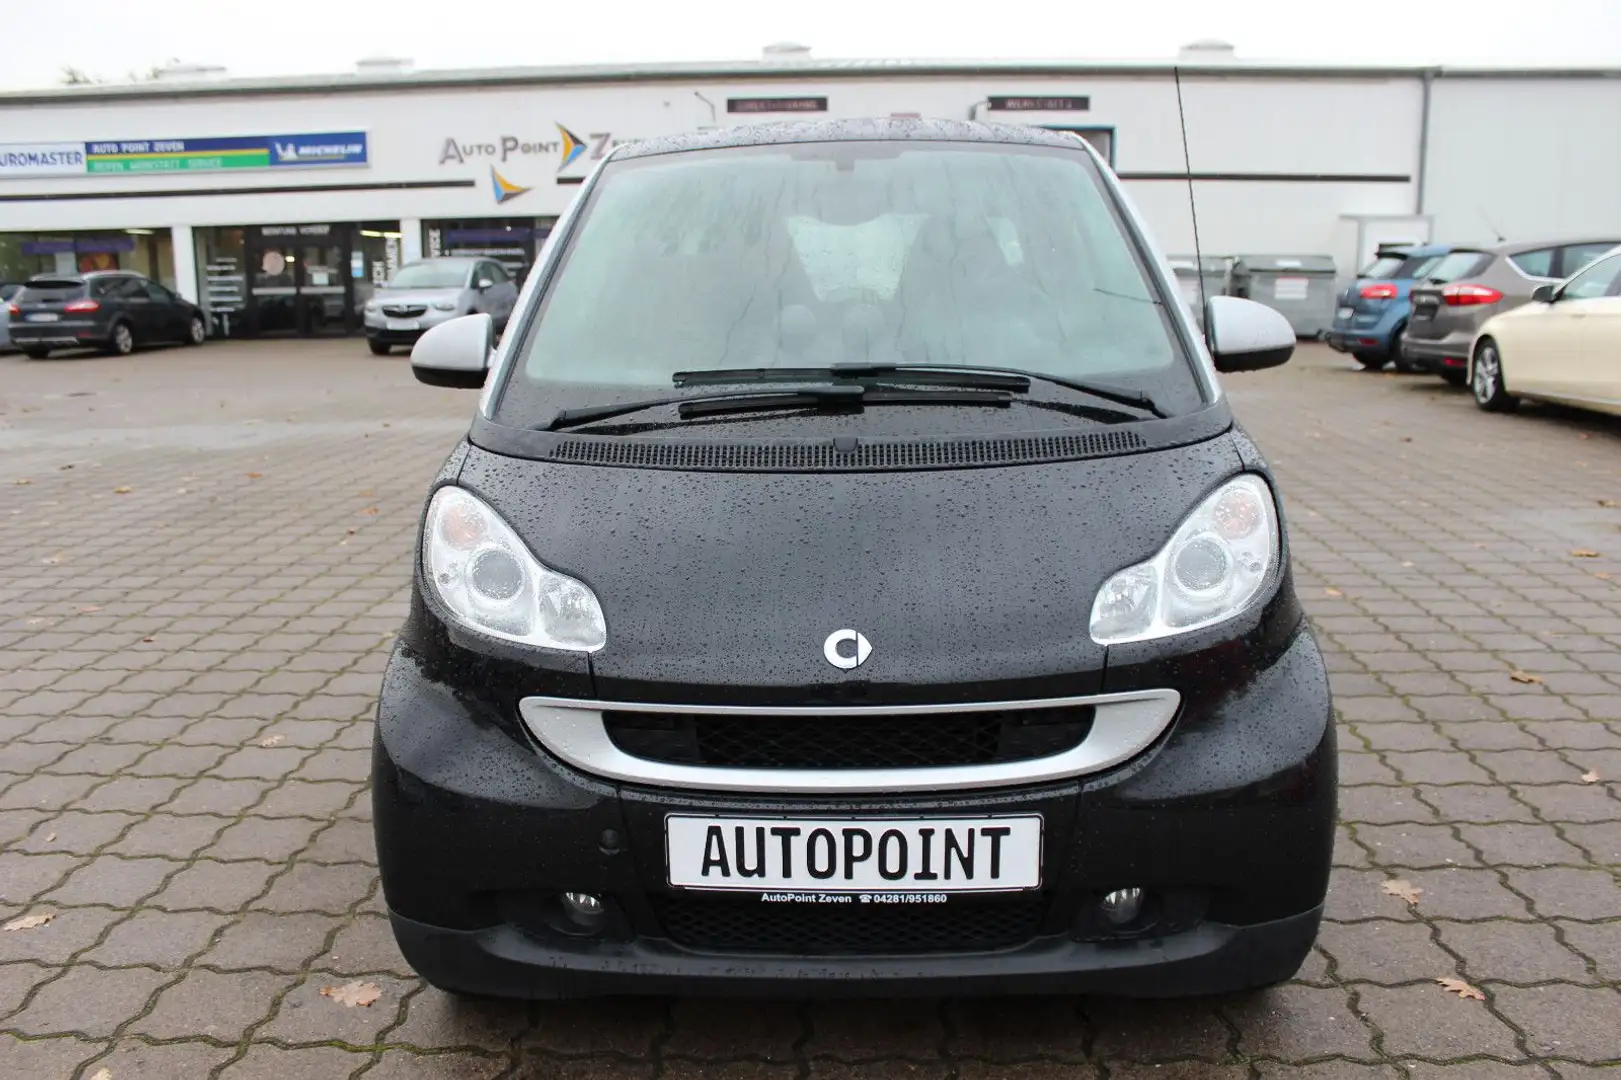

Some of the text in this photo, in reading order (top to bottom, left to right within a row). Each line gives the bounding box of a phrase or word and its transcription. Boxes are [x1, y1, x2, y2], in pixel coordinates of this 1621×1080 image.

[701, 825, 1011, 880] AUTOPOINT
[761, 892, 947, 903] AutoPoint Zeven 04281/951860
